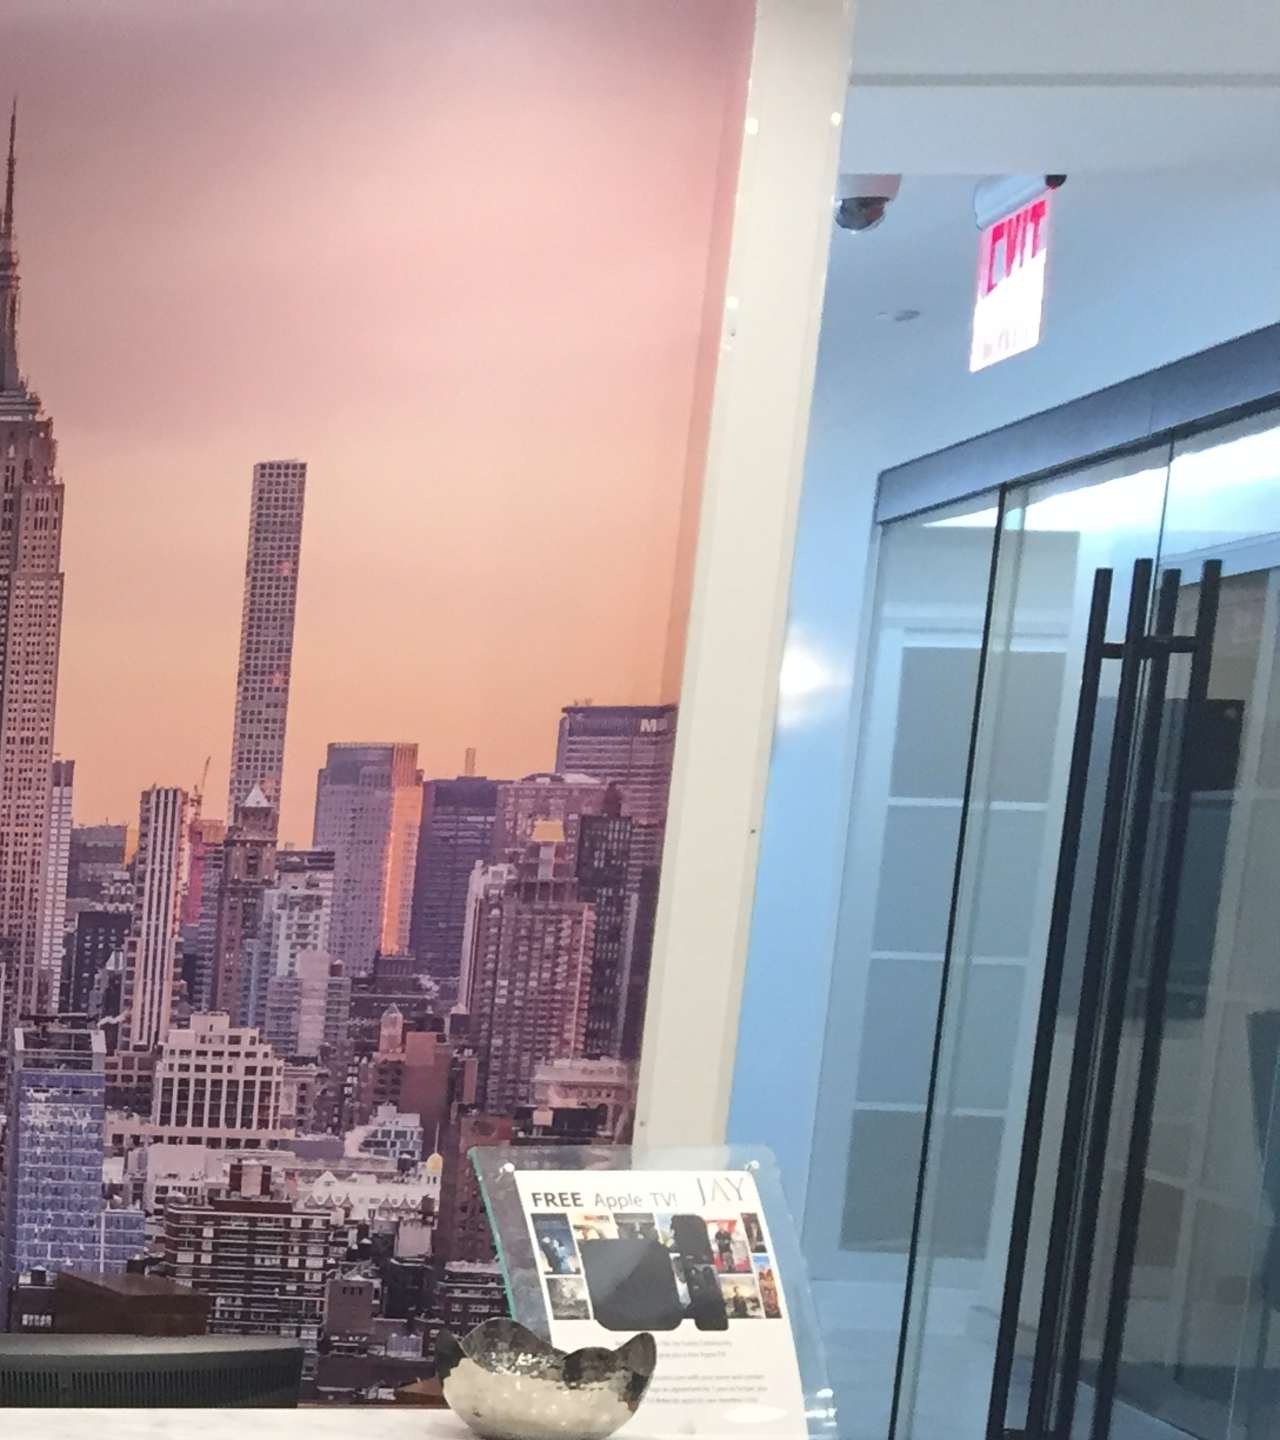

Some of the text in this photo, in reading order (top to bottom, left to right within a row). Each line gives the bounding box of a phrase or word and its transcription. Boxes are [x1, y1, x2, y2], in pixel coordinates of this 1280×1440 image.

[531, 1192, 678, 1210] FREE Apple TV!
[697, 1177, 744, 1206] JAY
